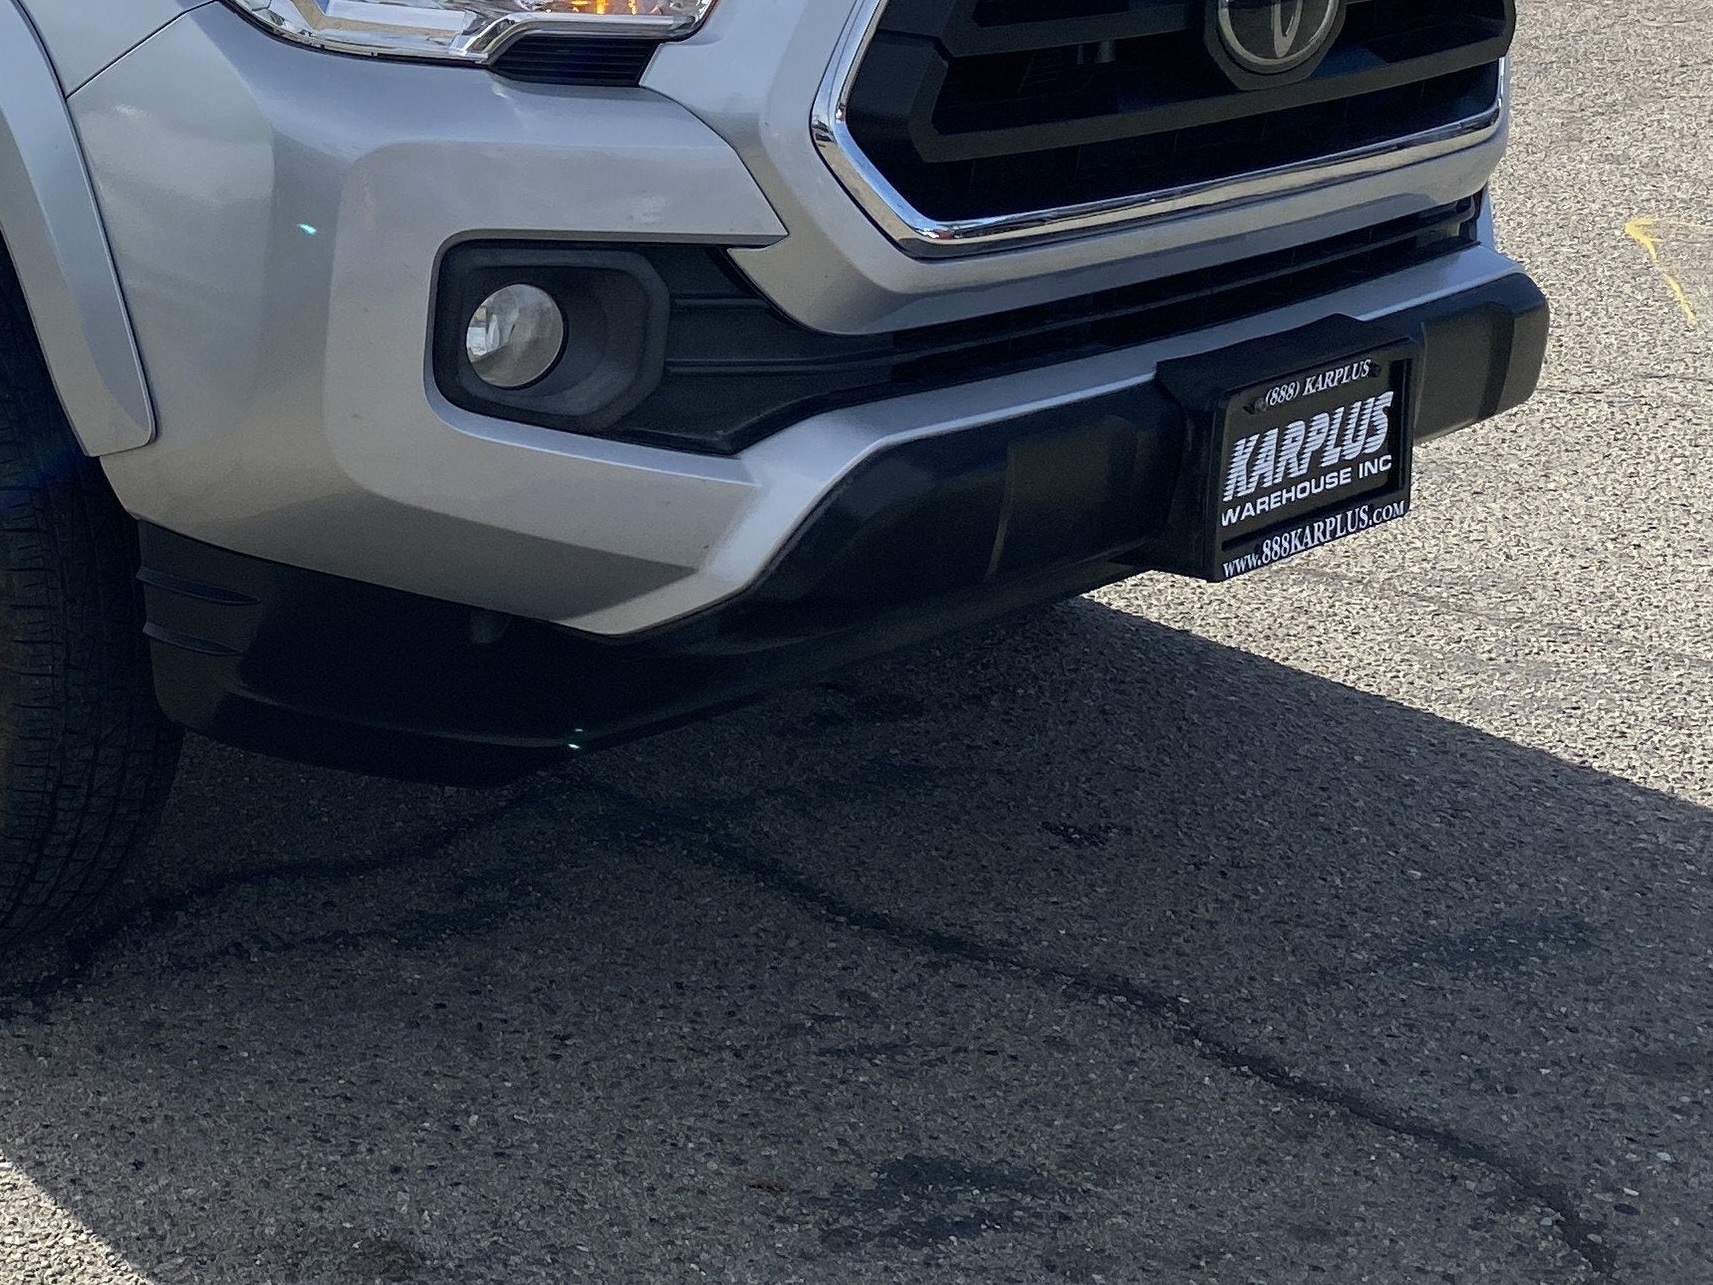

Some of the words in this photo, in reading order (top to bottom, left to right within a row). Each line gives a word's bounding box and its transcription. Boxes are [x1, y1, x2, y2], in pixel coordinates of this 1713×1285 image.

[1265, 382, 1300, 407] (888)
[1303, 359, 1371, 397] KARPLUS
[1223, 391, 1394, 502] KARPLUS
[1222, 467, 1352, 527] WAREHOUSE
[1359, 455, 1392, 479] INC
